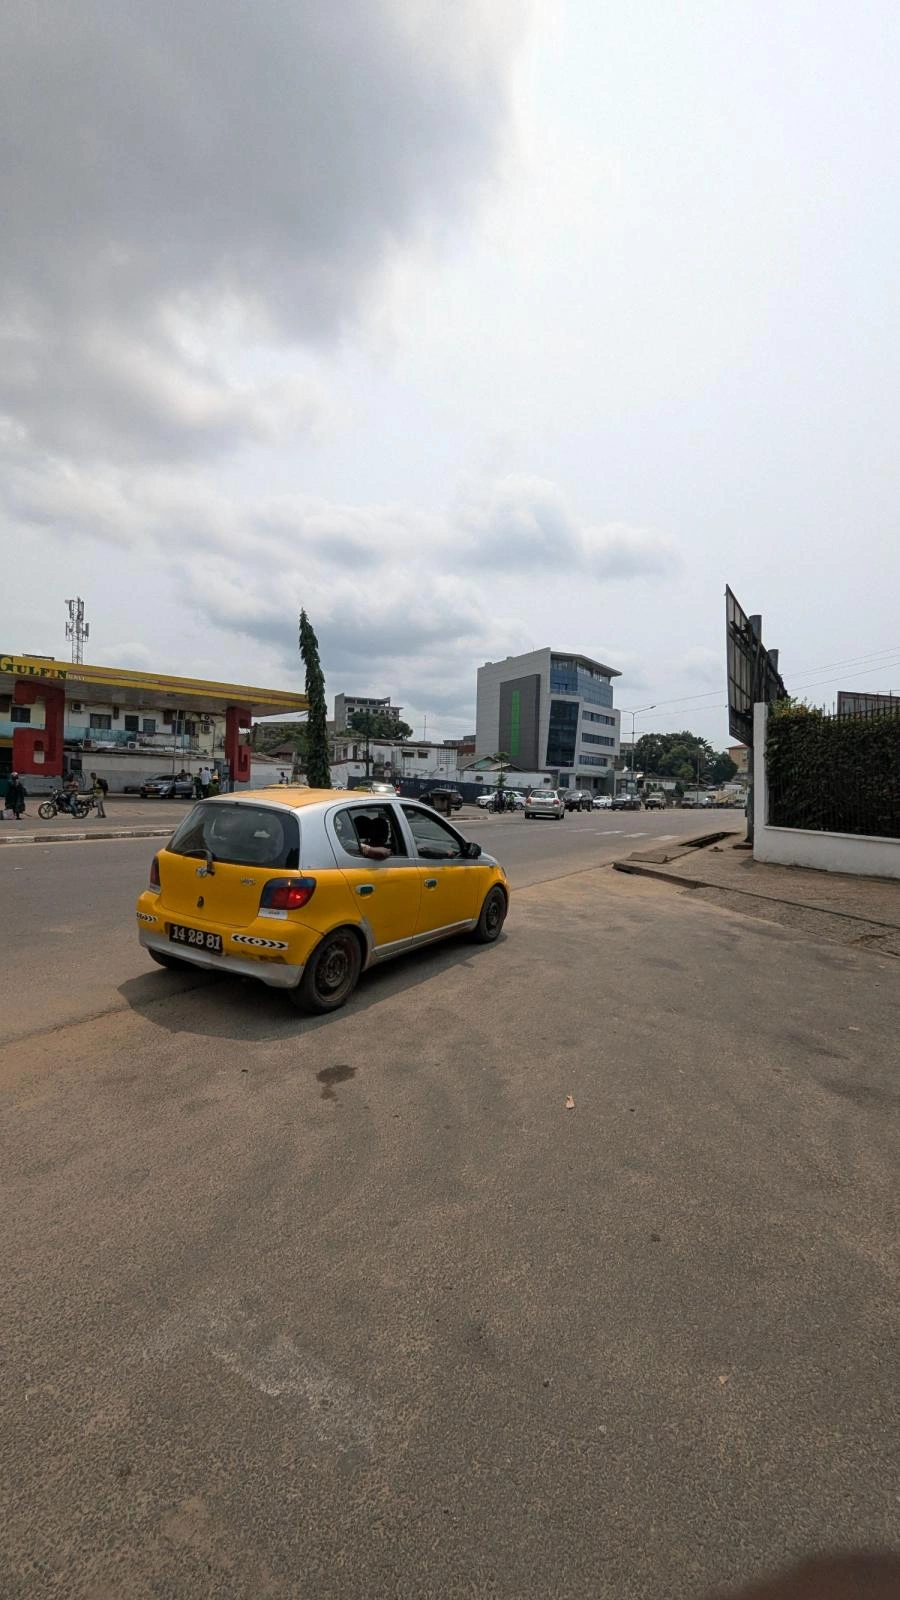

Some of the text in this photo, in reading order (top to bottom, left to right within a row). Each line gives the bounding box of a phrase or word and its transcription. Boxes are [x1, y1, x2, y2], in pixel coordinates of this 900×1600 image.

[0, 655, 68, 680] GULFIN
[172, 926, 221, 950] 14 28 81
